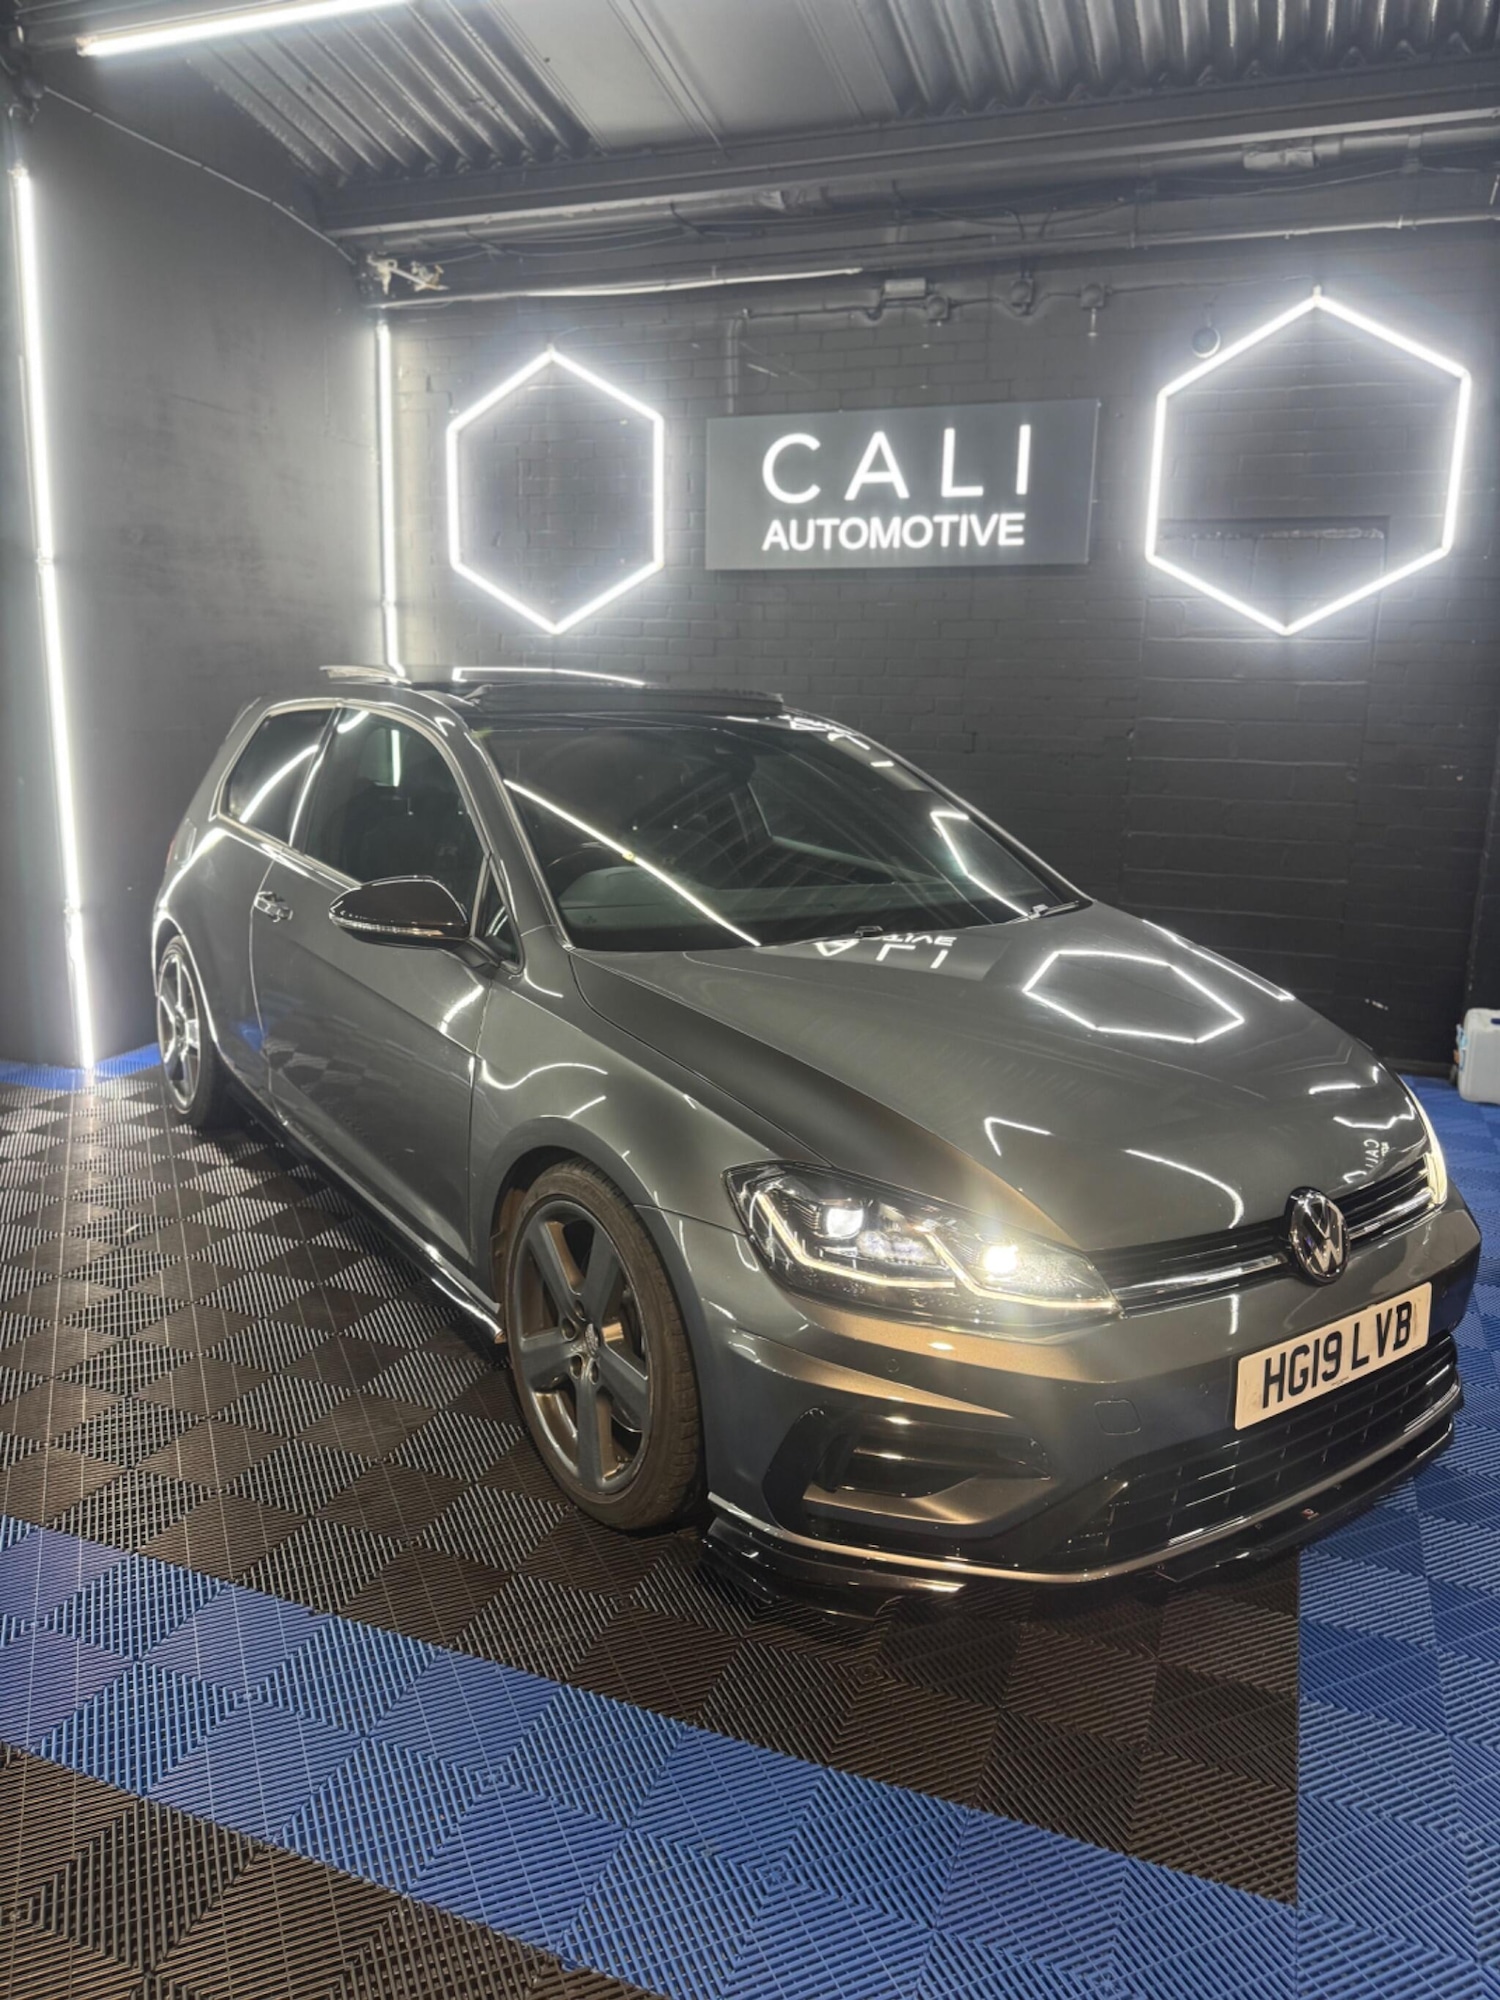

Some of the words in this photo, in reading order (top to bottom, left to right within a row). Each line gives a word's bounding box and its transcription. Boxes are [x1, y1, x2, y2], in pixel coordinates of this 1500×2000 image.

[762, 424, 1031, 504] CALI
[762, 512, 1026, 552] AUTOMOTIVE
[1262, 1330, 1343, 1410] HG19
[1350, 1300, 1413, 1371] LVB
